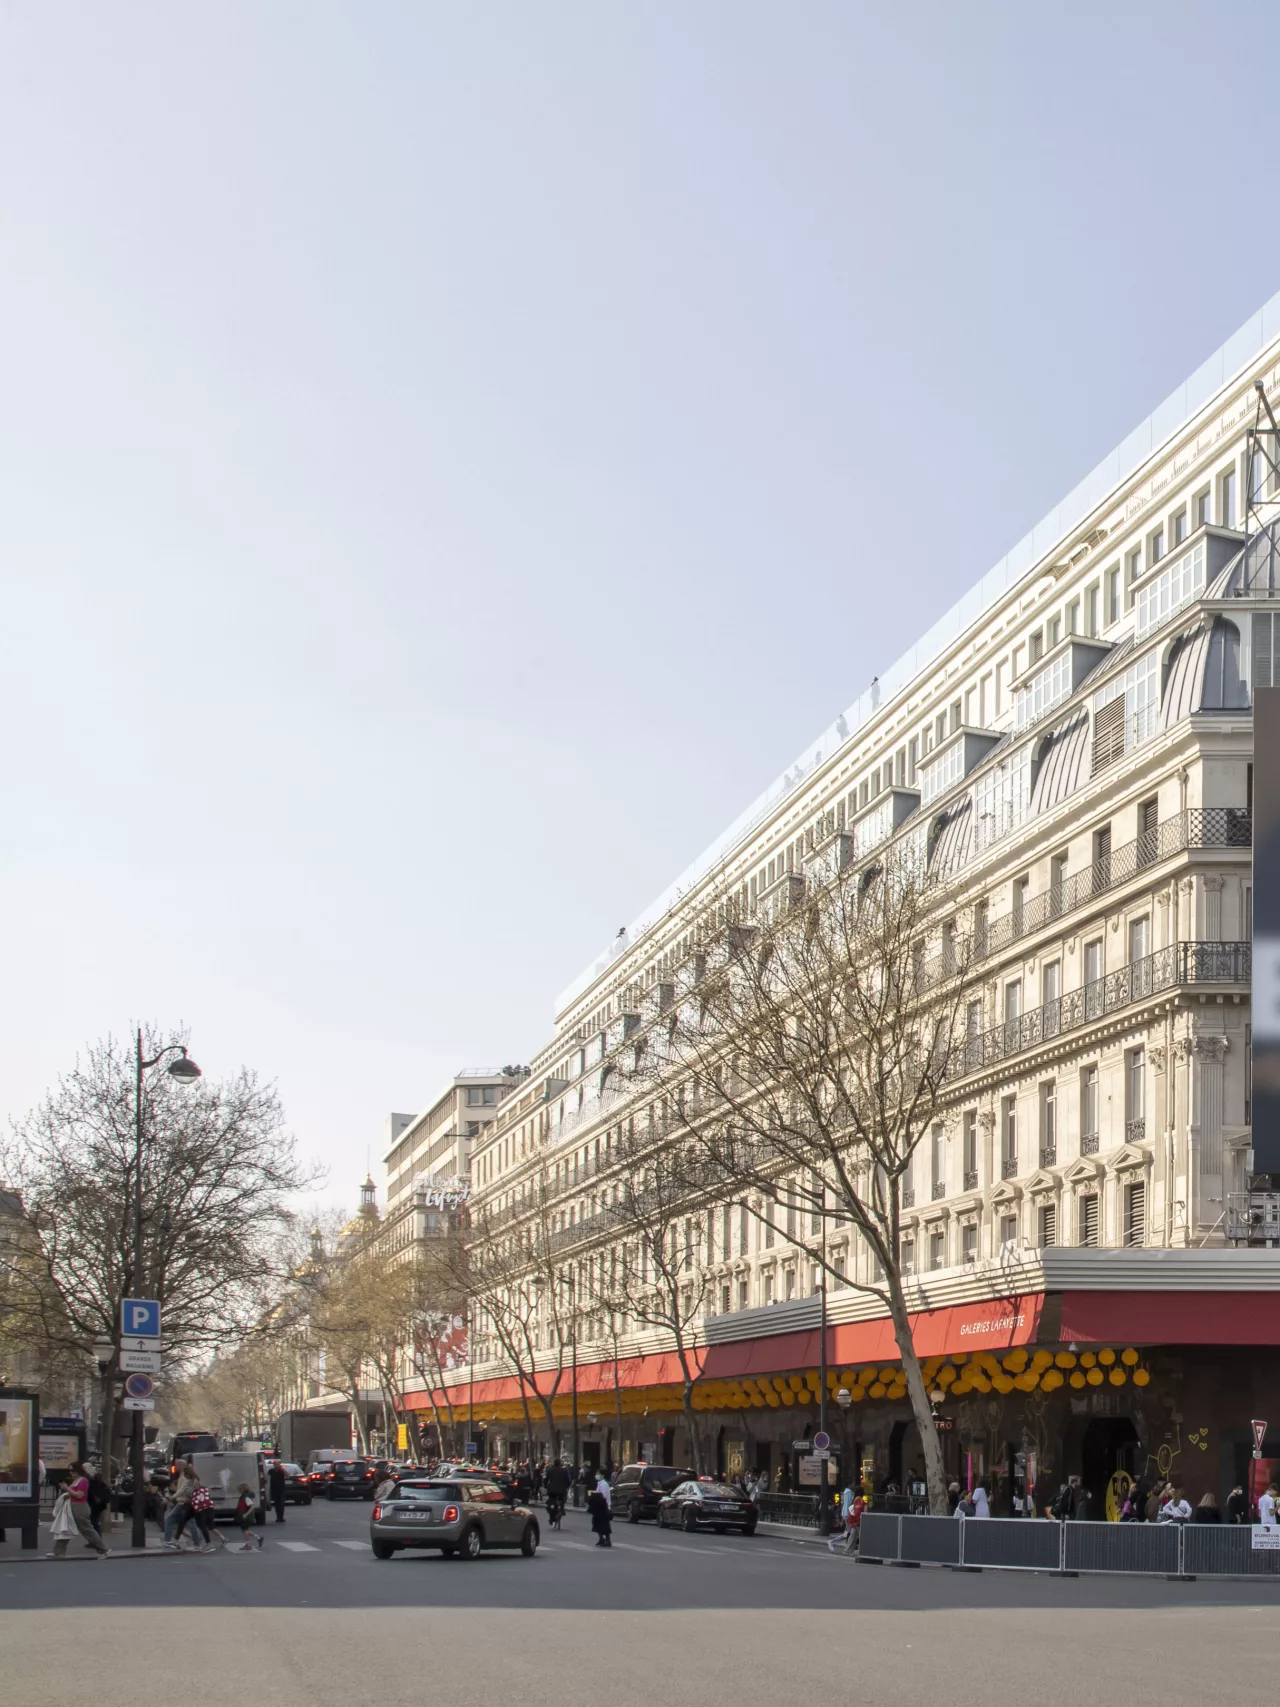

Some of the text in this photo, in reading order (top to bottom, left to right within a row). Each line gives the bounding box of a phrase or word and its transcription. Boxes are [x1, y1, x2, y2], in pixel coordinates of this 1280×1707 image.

[132, 1306, 150, 1329] P
[961, 1315, 1024, 1335] GALERIES LAFAYETTE
[934, 1421, 953, 1430] TRO
